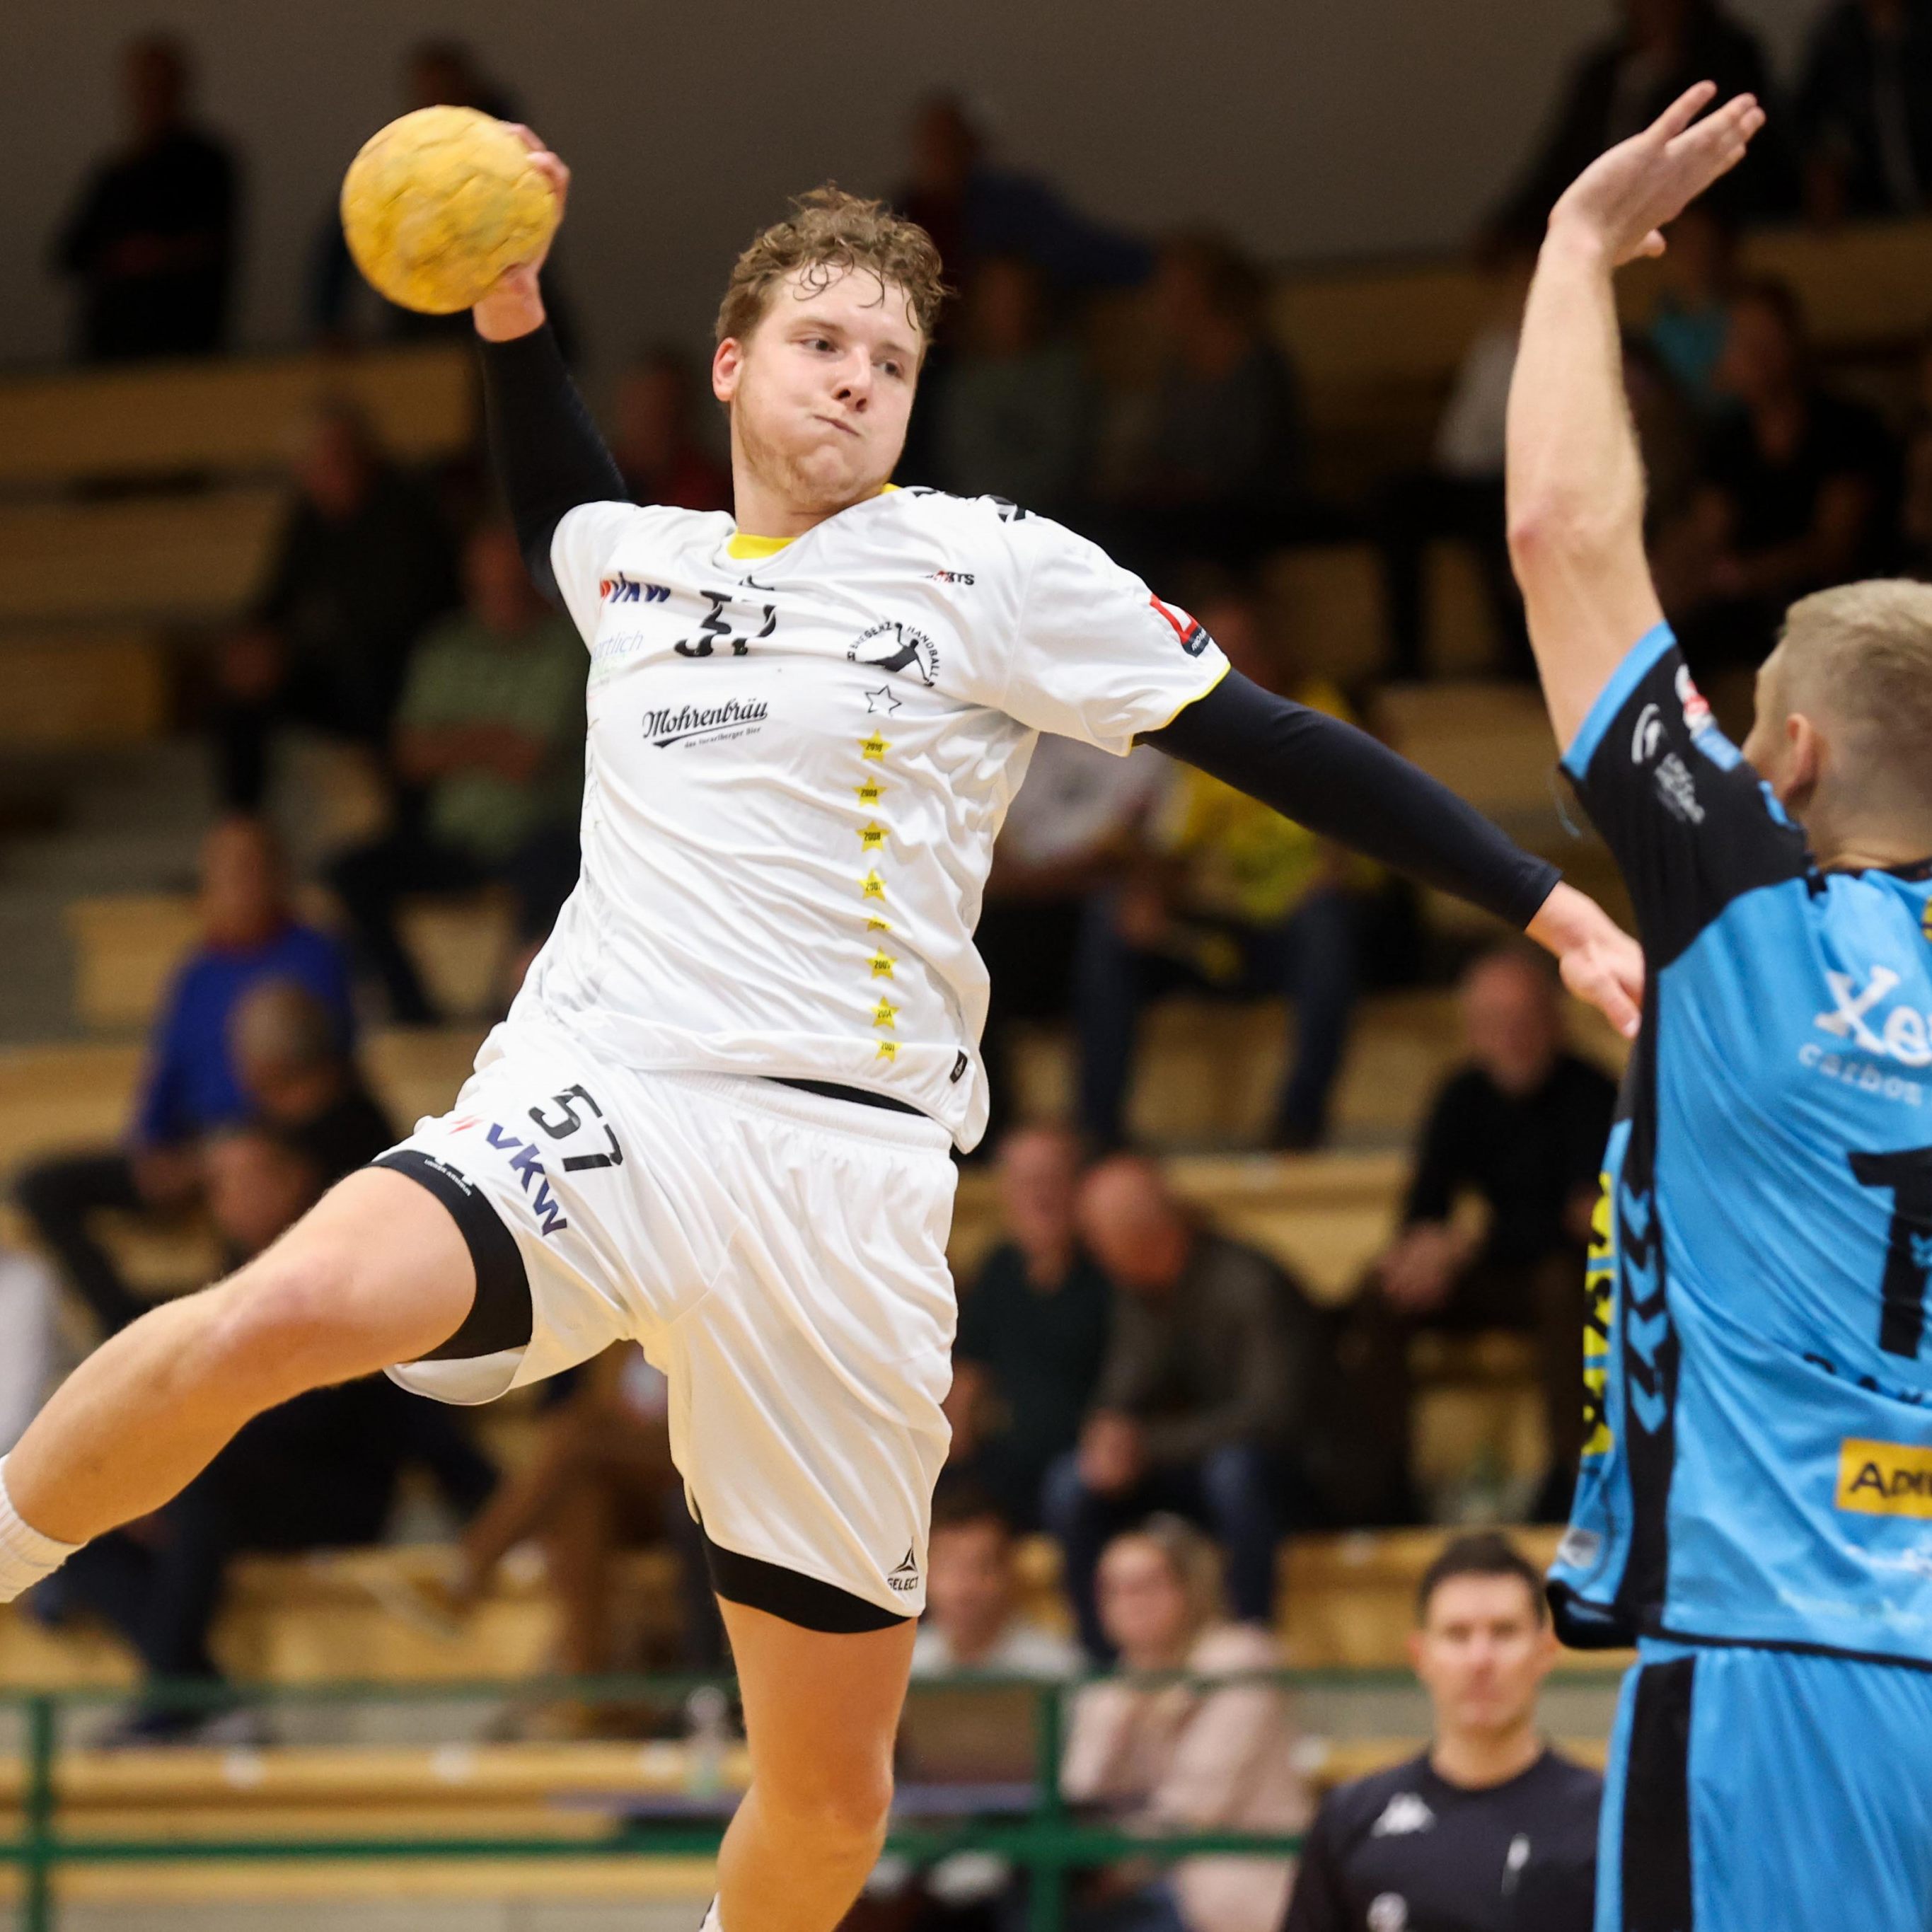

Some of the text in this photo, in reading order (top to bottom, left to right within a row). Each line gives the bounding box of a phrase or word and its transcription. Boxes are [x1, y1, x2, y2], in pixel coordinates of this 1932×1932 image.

[906, 626, 939, 677] HANDBALL
[642, 696, 768, 739] Mohrenbräu
[528, 1084, 623, 1172] 57
[485, 1122, 567, 1237] VKW
[887, 1575, 919, 1591] SELECT
